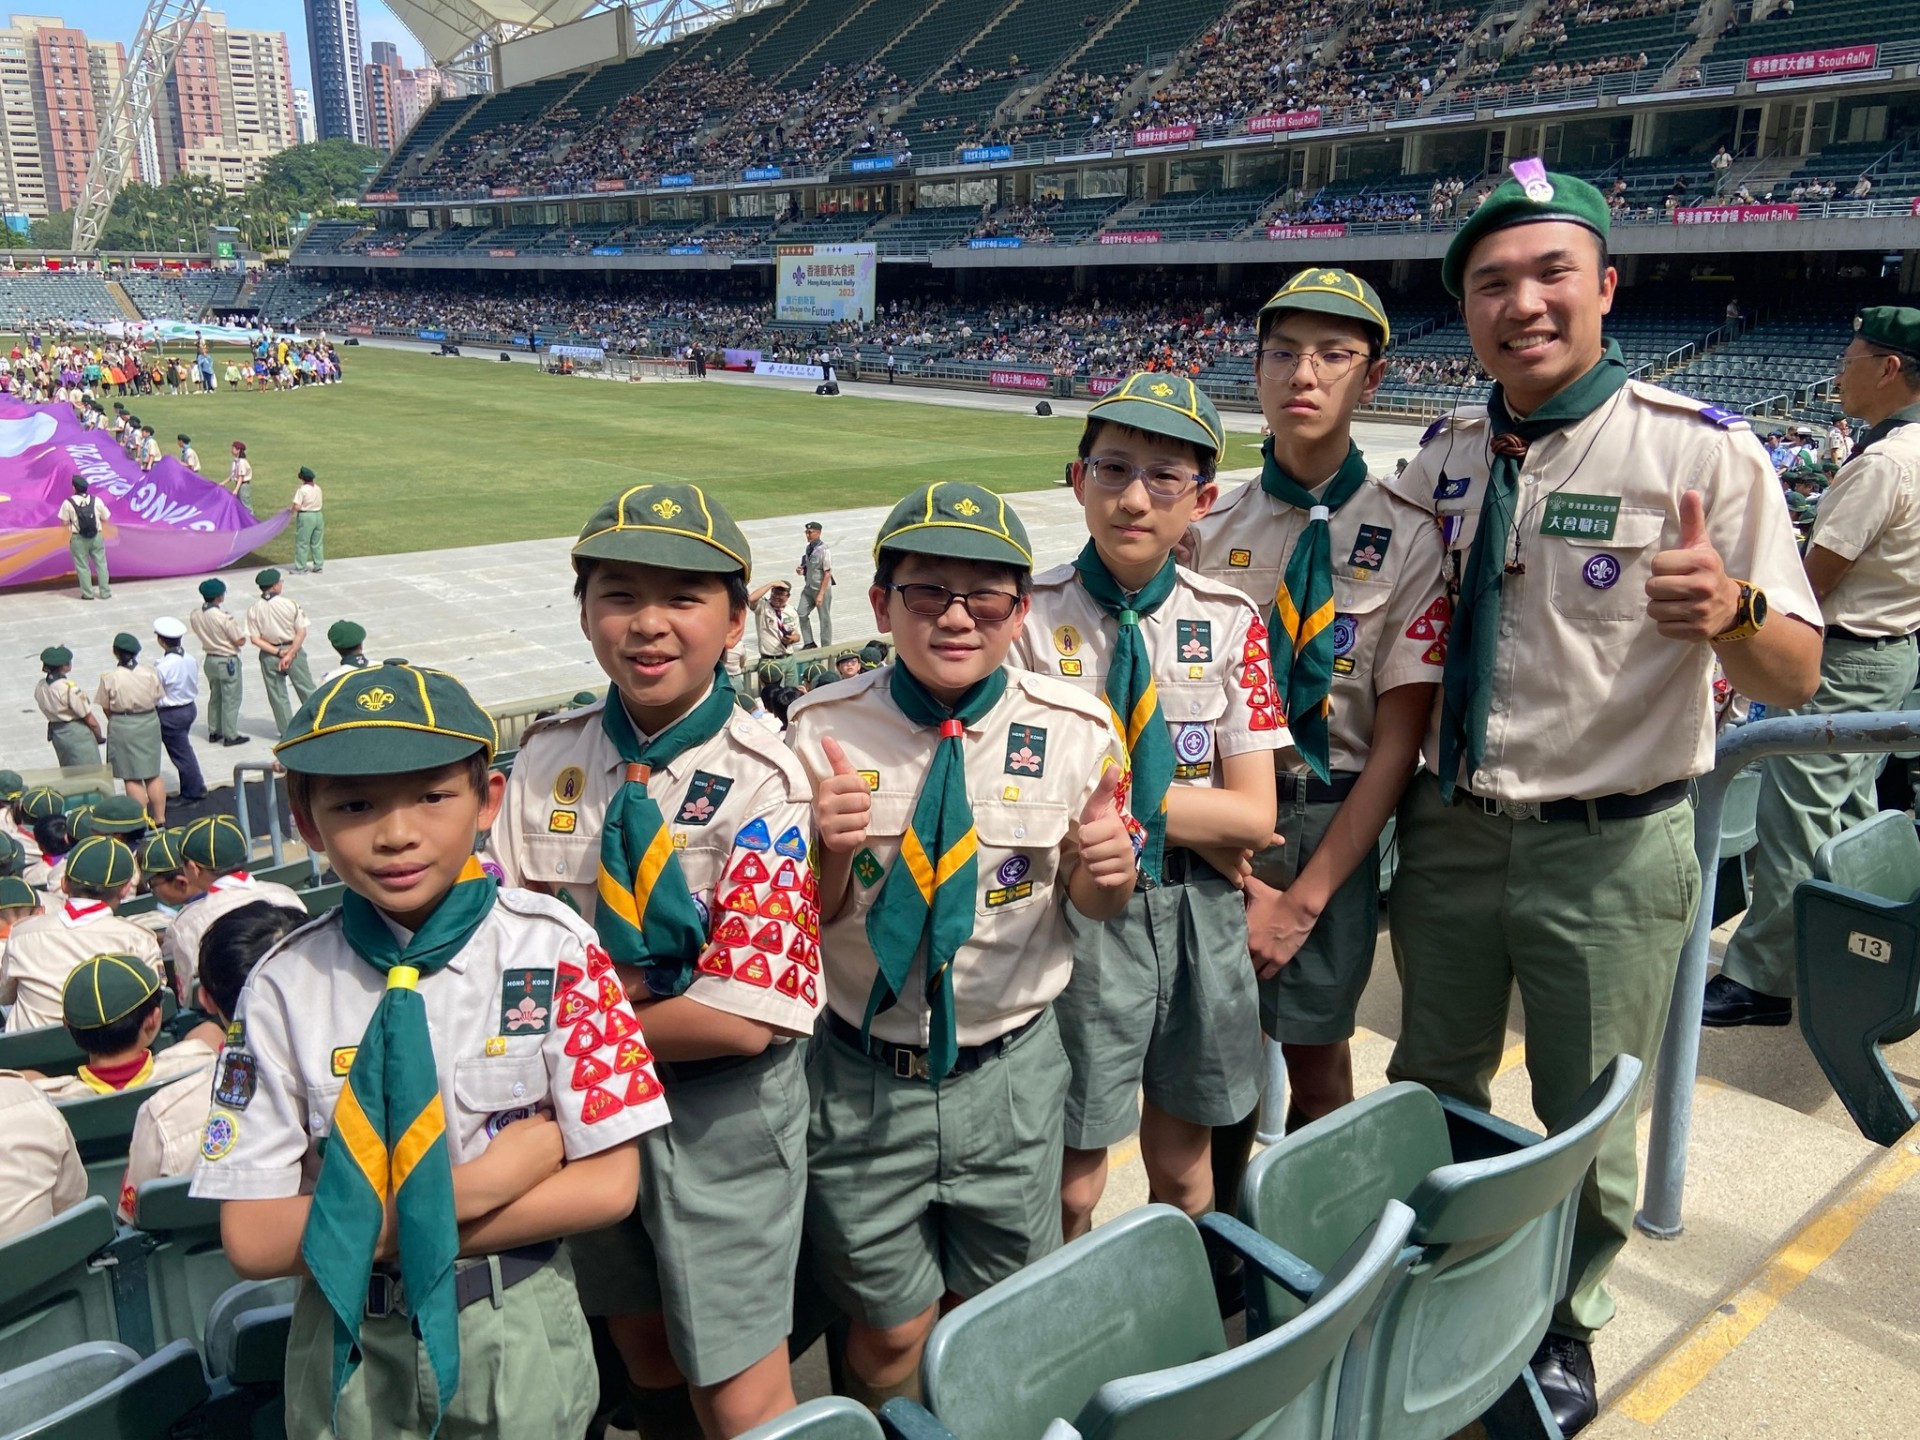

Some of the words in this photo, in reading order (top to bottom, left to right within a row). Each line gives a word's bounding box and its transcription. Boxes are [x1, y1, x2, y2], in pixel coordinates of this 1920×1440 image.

[1752, 55, 1815, 74] 香港童軍大會操
[1818, 55, 1845, 68] Scout
[1846, 51, 1871, 65] Rally
[1743, 210, 1769, 222] Scout
[1770, 209, 1794, 221] Rally
[807, 279, 819, 287] Hong
[820, 279, 831, 287] Kong
[843, 279, 855, 287] Rally
[803, 305, 811, 313] the
[811, 305, 835, 317] Future
[1548, 515, 1610, 535] 大會職員
[1858, 937, 1882, 957] 13
